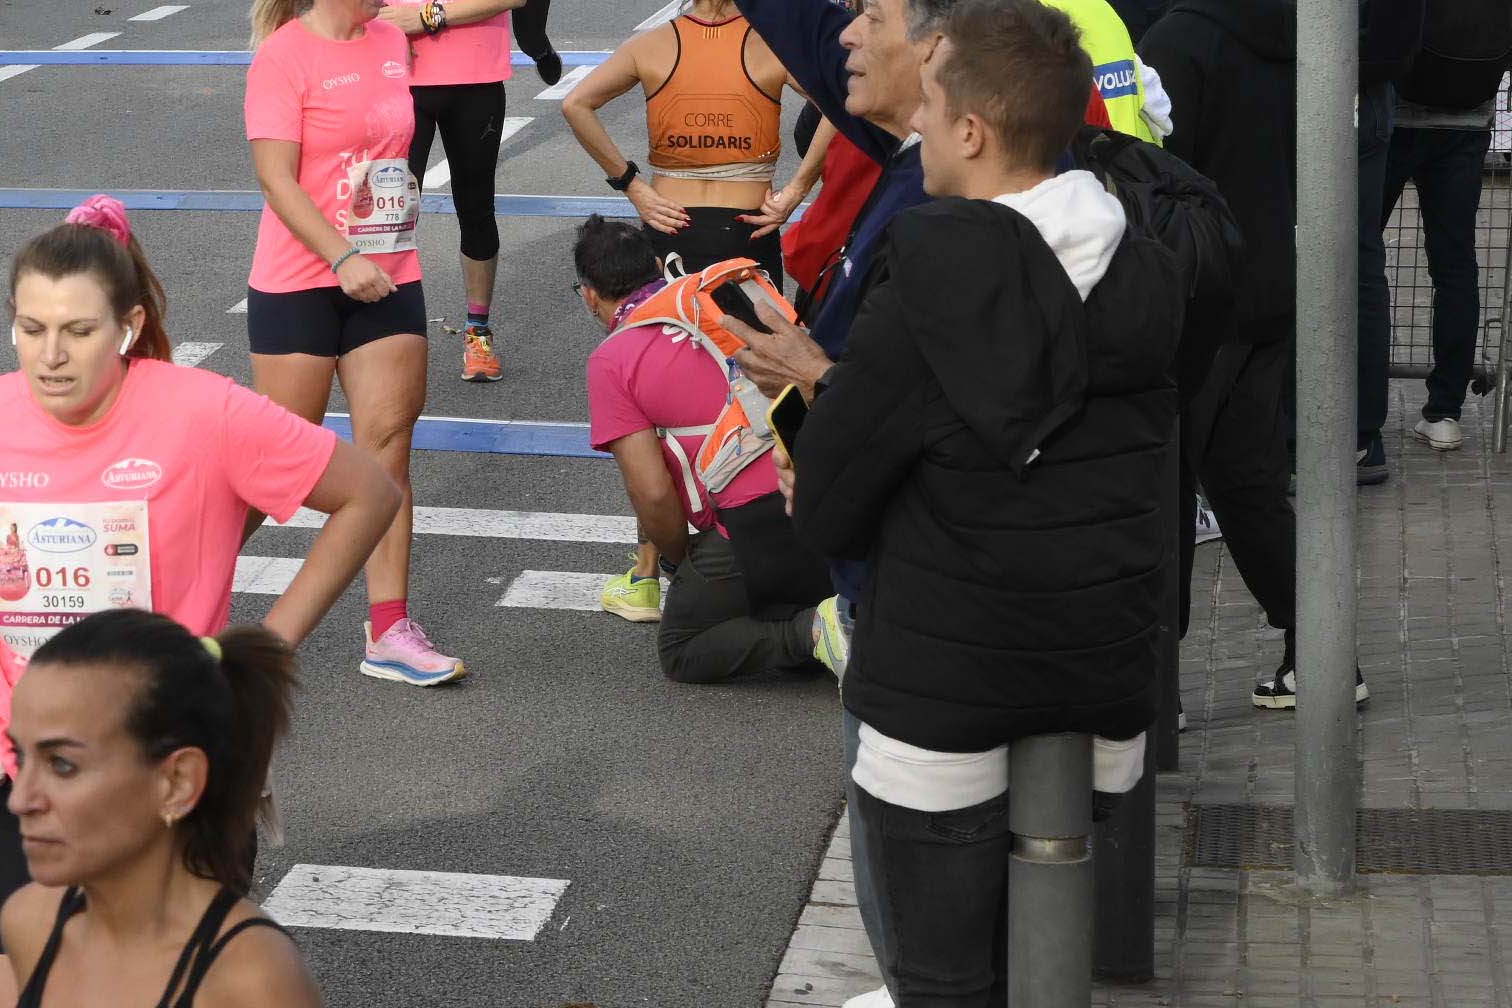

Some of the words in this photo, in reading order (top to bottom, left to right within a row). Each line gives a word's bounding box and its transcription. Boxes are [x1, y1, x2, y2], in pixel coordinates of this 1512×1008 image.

[323, 72, 361, 90] OYSHO
[684, 112, 735, 128] CORRE
[667, 135, 752, 151] SOLIDARIS
[376, 195, 405, 209] 016
[384, 213, 400, 222] 778
[103, 523, 136, 533] SUMA
[33, 530, 91, 544] ASTURIANA
[36, 566, 91, 588] 016
[42, 595, 85, 609] 30159
[2, 615, 46, 625] CARRERA
[47, 615, 62, 624] DE
[62, 616, 75, 624] LA
